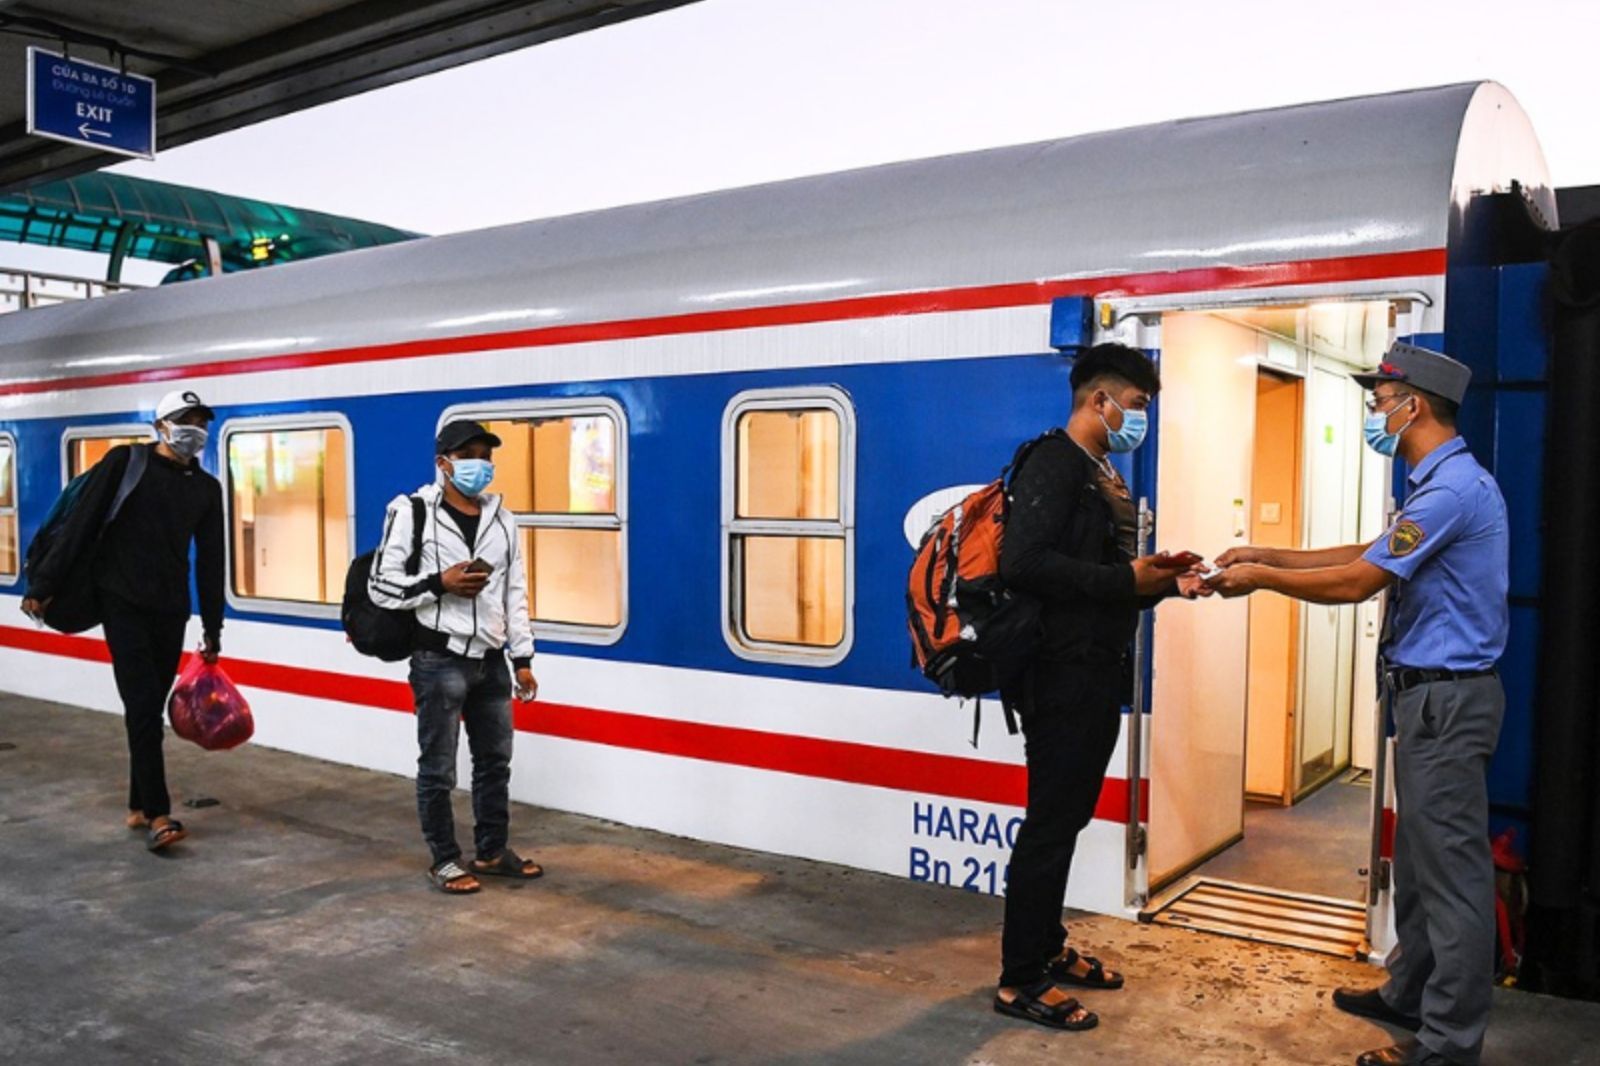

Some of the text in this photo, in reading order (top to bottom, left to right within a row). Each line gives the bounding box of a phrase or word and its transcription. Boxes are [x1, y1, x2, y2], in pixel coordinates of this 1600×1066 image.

[81, 72, 98, 85] RA
[101, 76, 119, 90] SỐ
[76, 101, 113, 123] EXIT
[909, 846, 951, 886] Bn
